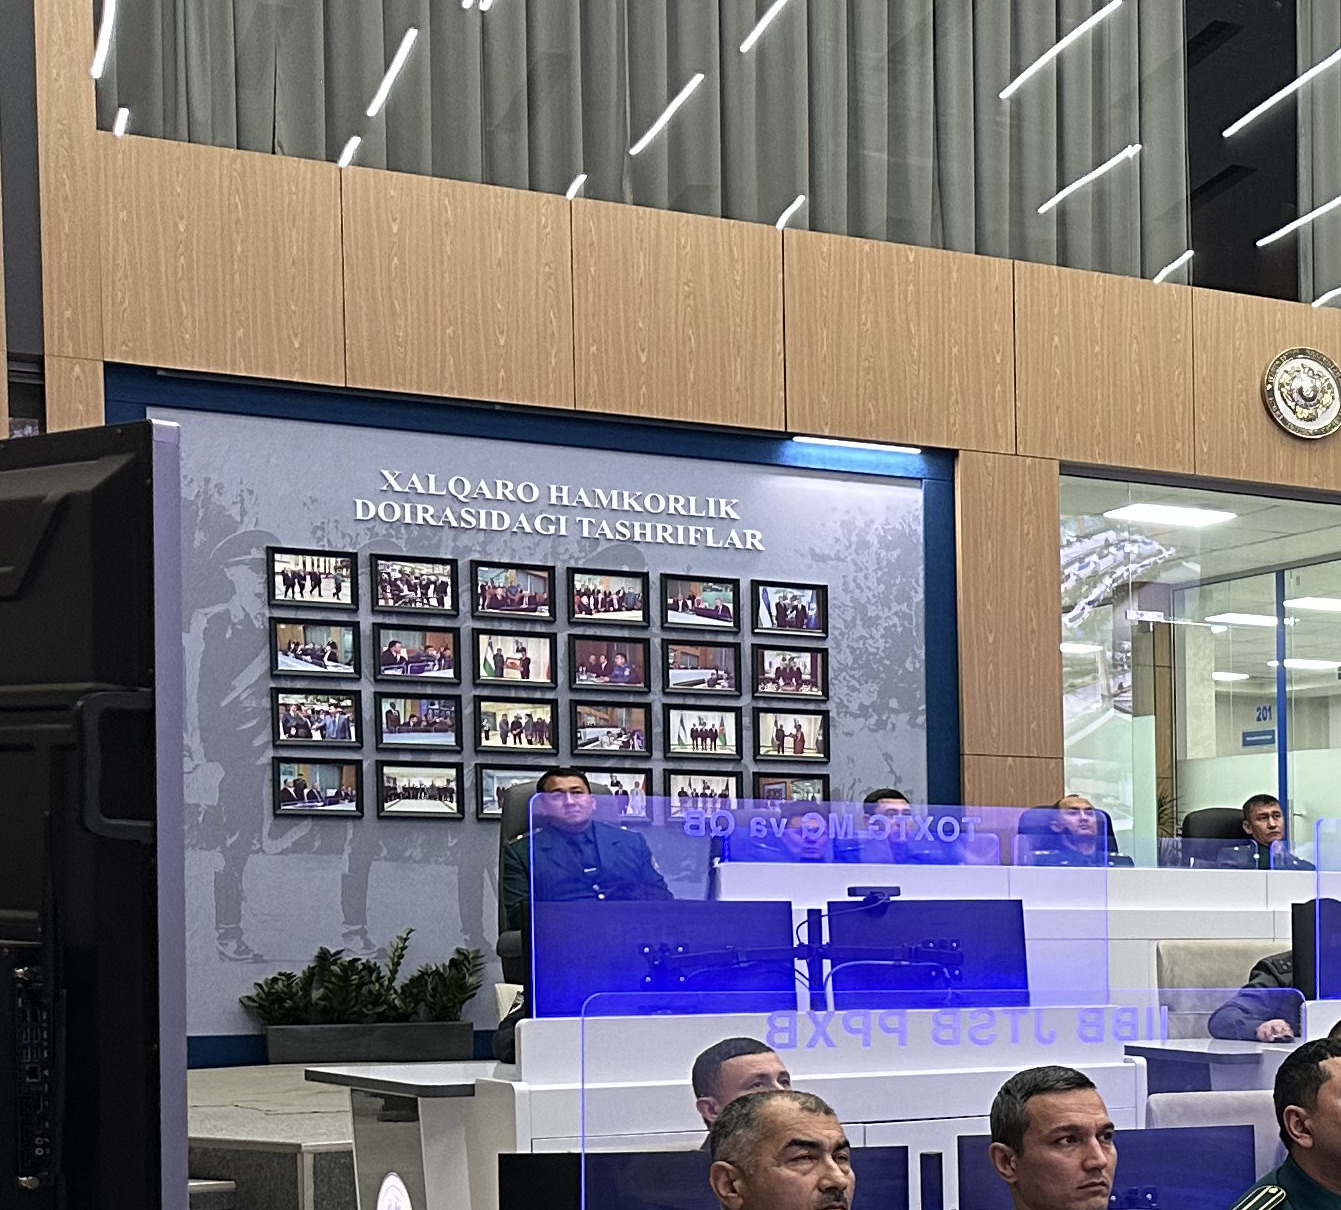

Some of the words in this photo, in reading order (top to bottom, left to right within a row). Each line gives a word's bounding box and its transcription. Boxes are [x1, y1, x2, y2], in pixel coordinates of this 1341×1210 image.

[379, 469, 540, 504] XALQARO
[547, 484, 741, 520] HAMKORLIK
[354, 499, 568, 536] DOIRASIDAGI
[575, 516, 766, 551] TASHRIFLAR
[1256, 704, 1272, 722] 201
